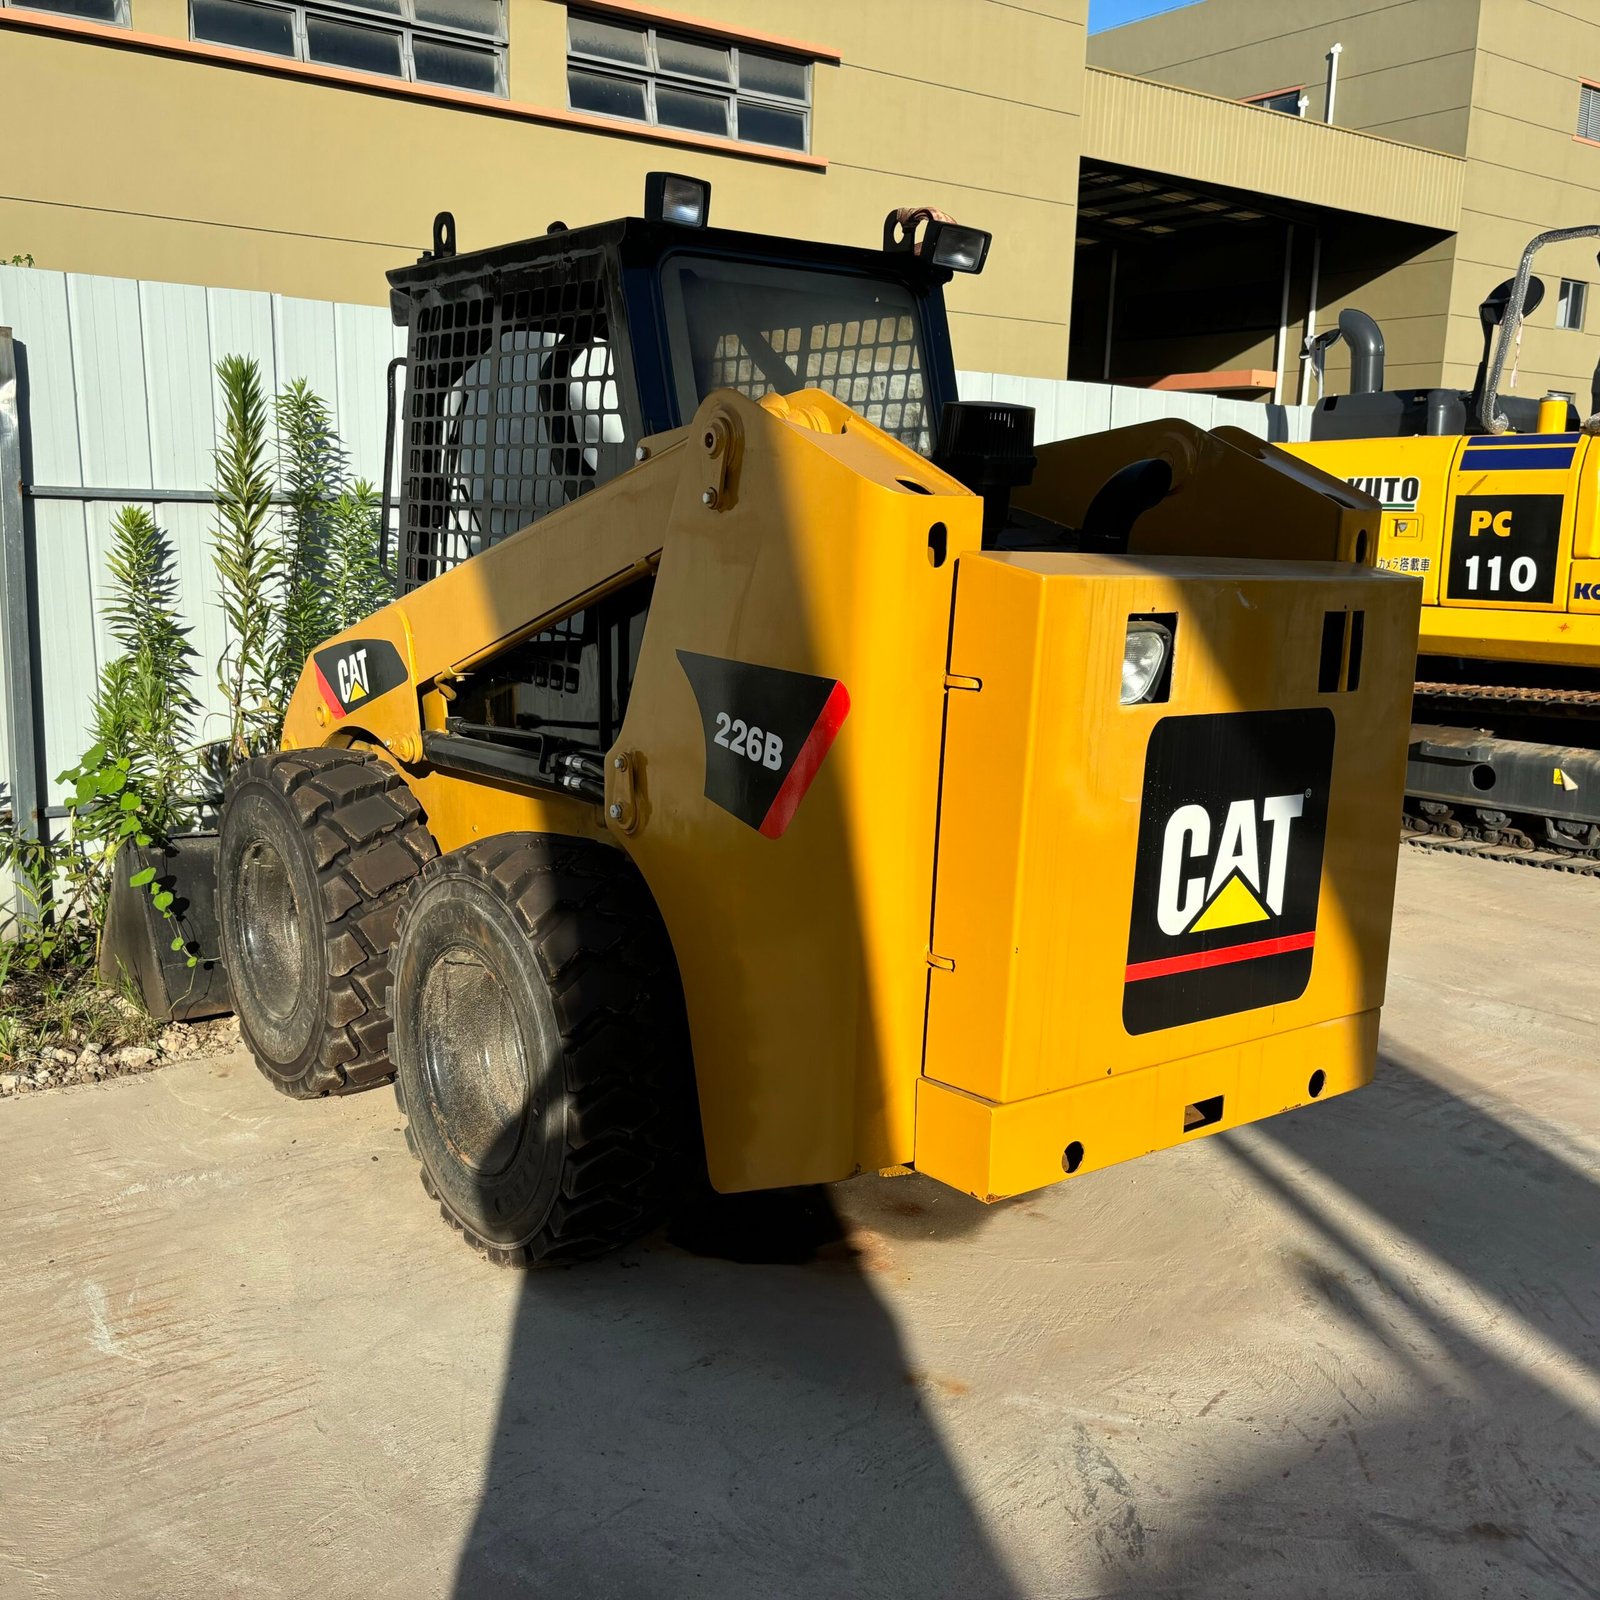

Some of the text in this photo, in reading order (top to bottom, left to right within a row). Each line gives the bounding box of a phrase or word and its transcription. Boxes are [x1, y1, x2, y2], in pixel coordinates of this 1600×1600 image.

[1469, 510, 1512, 537] PC
[1378, 557, 1430, 571] カメラ搭載車
[1465, 555, 1537, 592] 110
[338, 648, 369, 704] CAT
[714, 712, 783, 770] 226B
[1157, 793, 1304, 936] CAT
